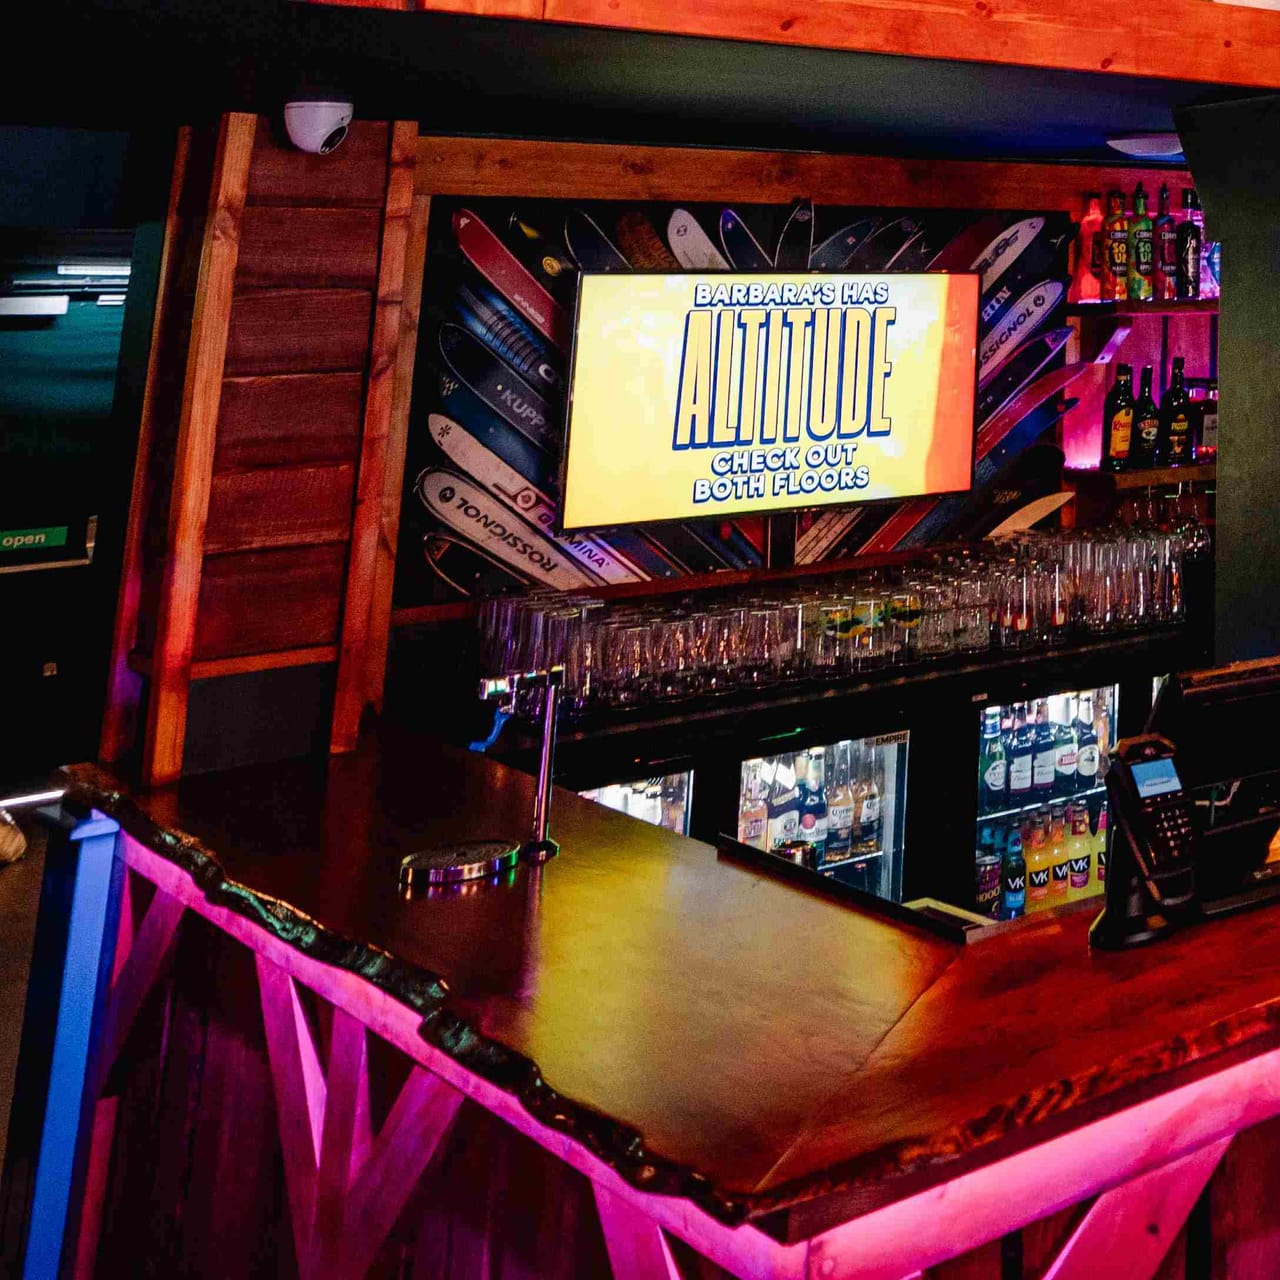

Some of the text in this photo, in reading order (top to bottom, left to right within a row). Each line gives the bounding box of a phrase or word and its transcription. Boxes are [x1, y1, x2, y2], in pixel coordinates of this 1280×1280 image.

[694, 281, 890, 307] BARBARA'S HAS
[980, 307, 1035, 368] SSIGNOL
[672, 306, 898, 451] ALTITUDE
[711, 443, 858, 477] CHECK OUT
[693, 466, 871, 503] BOTH FLOORS
[2, 533, 46, 549] open
[455, 496, 560, 573] ROSSIGNOL
[875, 732, 908, 746] EMPIRE
[1031, 870, 1049, 884] VK
[1070, 857, 1088, 871] VK
[1007, 876, 1025, 890] VK
